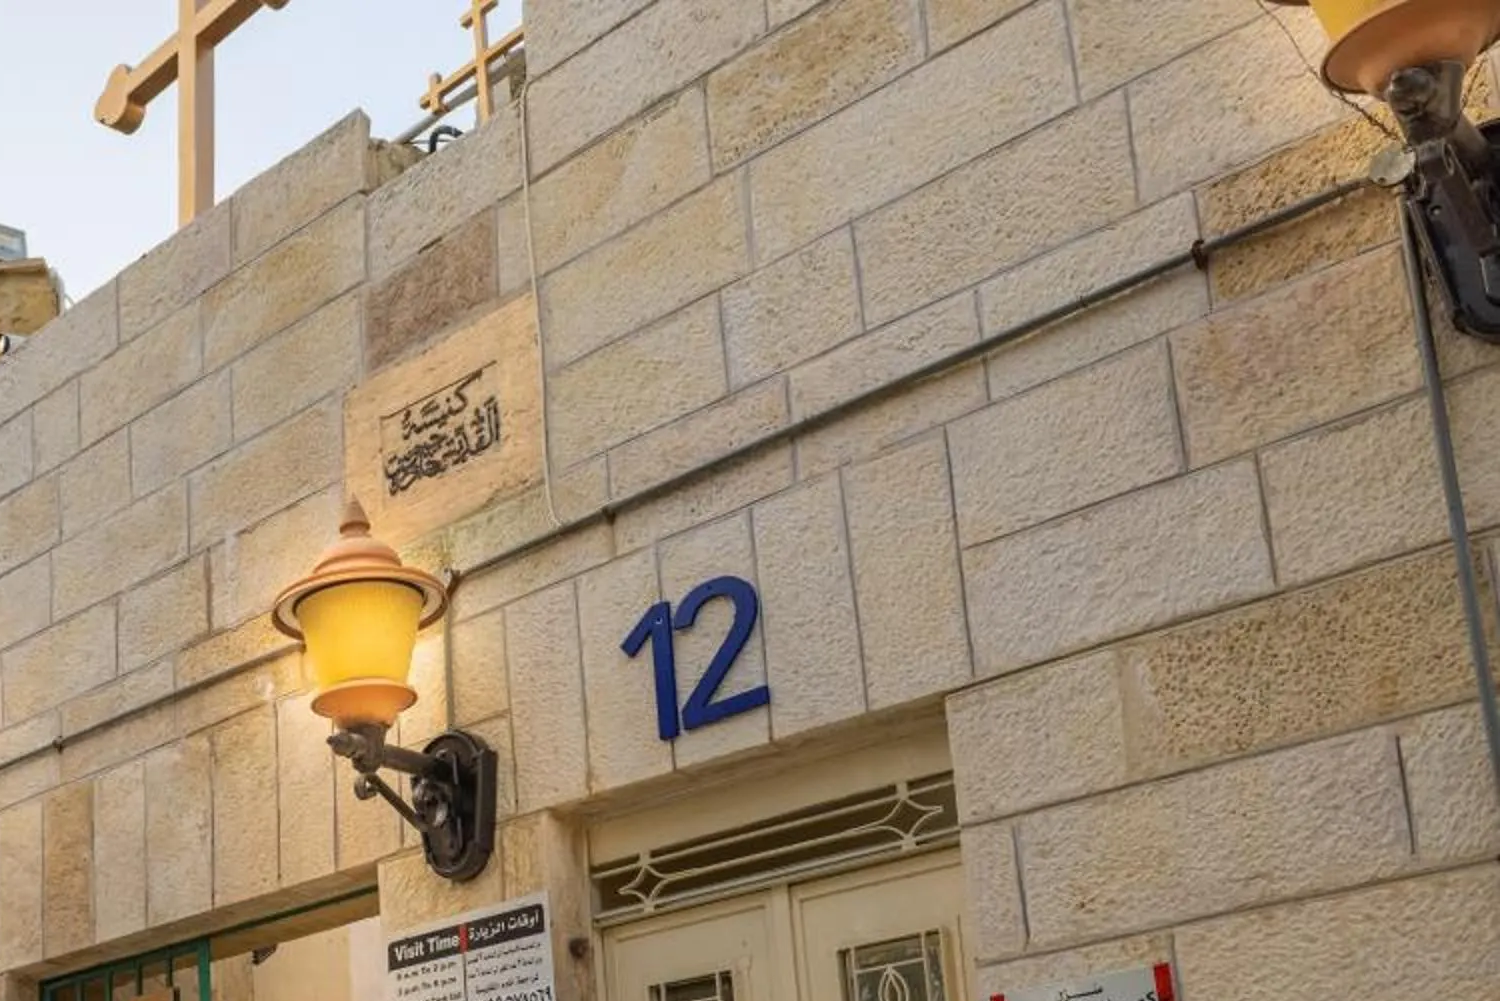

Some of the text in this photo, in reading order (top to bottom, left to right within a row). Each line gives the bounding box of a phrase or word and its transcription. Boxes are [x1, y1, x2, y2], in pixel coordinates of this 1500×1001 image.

[620, 575, 770, 741] 12
[395, 935, 460, 961] Visit Time
